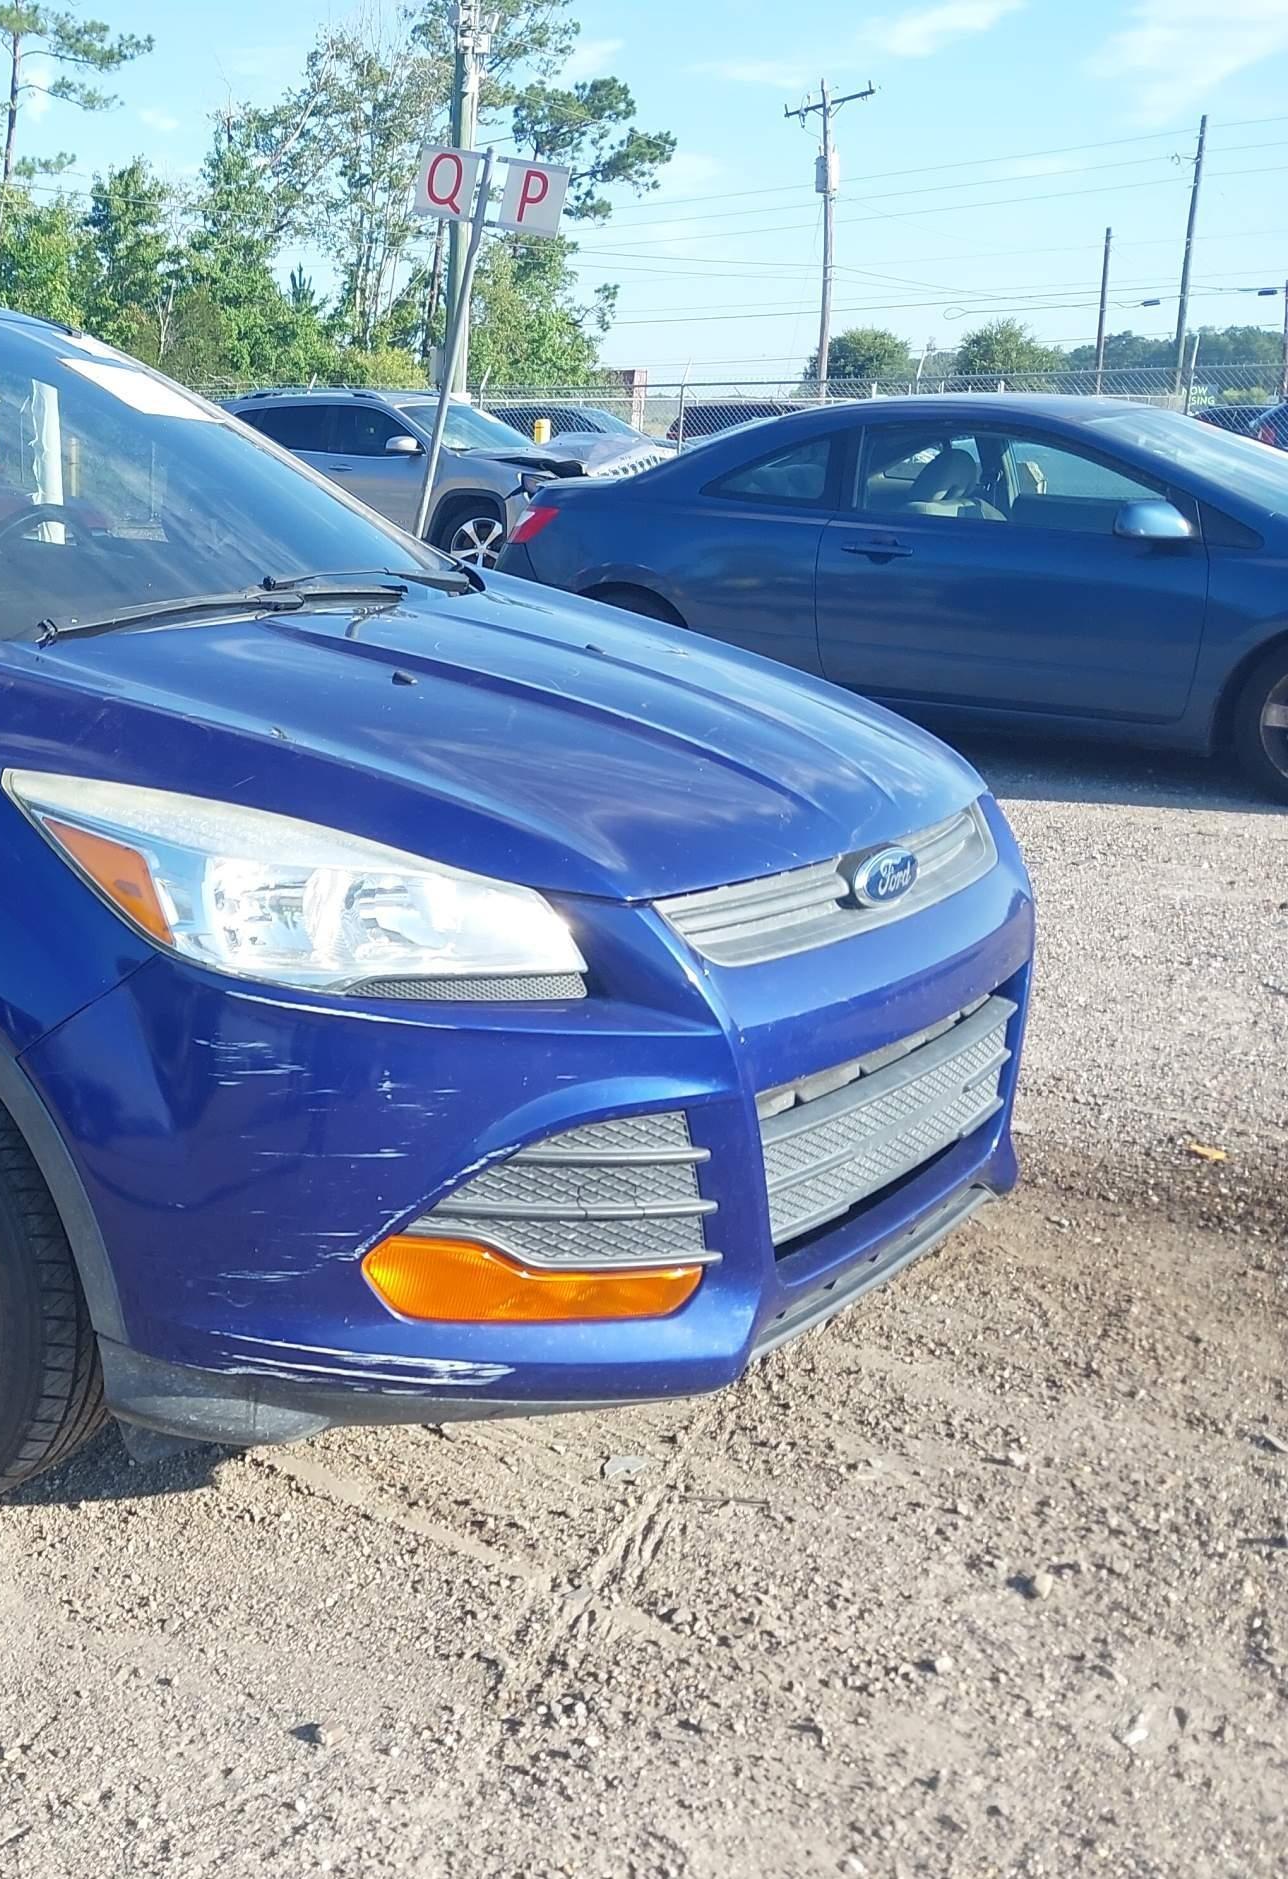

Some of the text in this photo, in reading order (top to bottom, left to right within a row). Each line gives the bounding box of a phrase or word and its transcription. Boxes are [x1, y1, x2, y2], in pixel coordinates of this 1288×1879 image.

[426, 152, 462, 215] Q
[517, 169, 550, 222] P
[1190, 396, 1216, 406] SING
[878, 858, 912, 896] Ford
